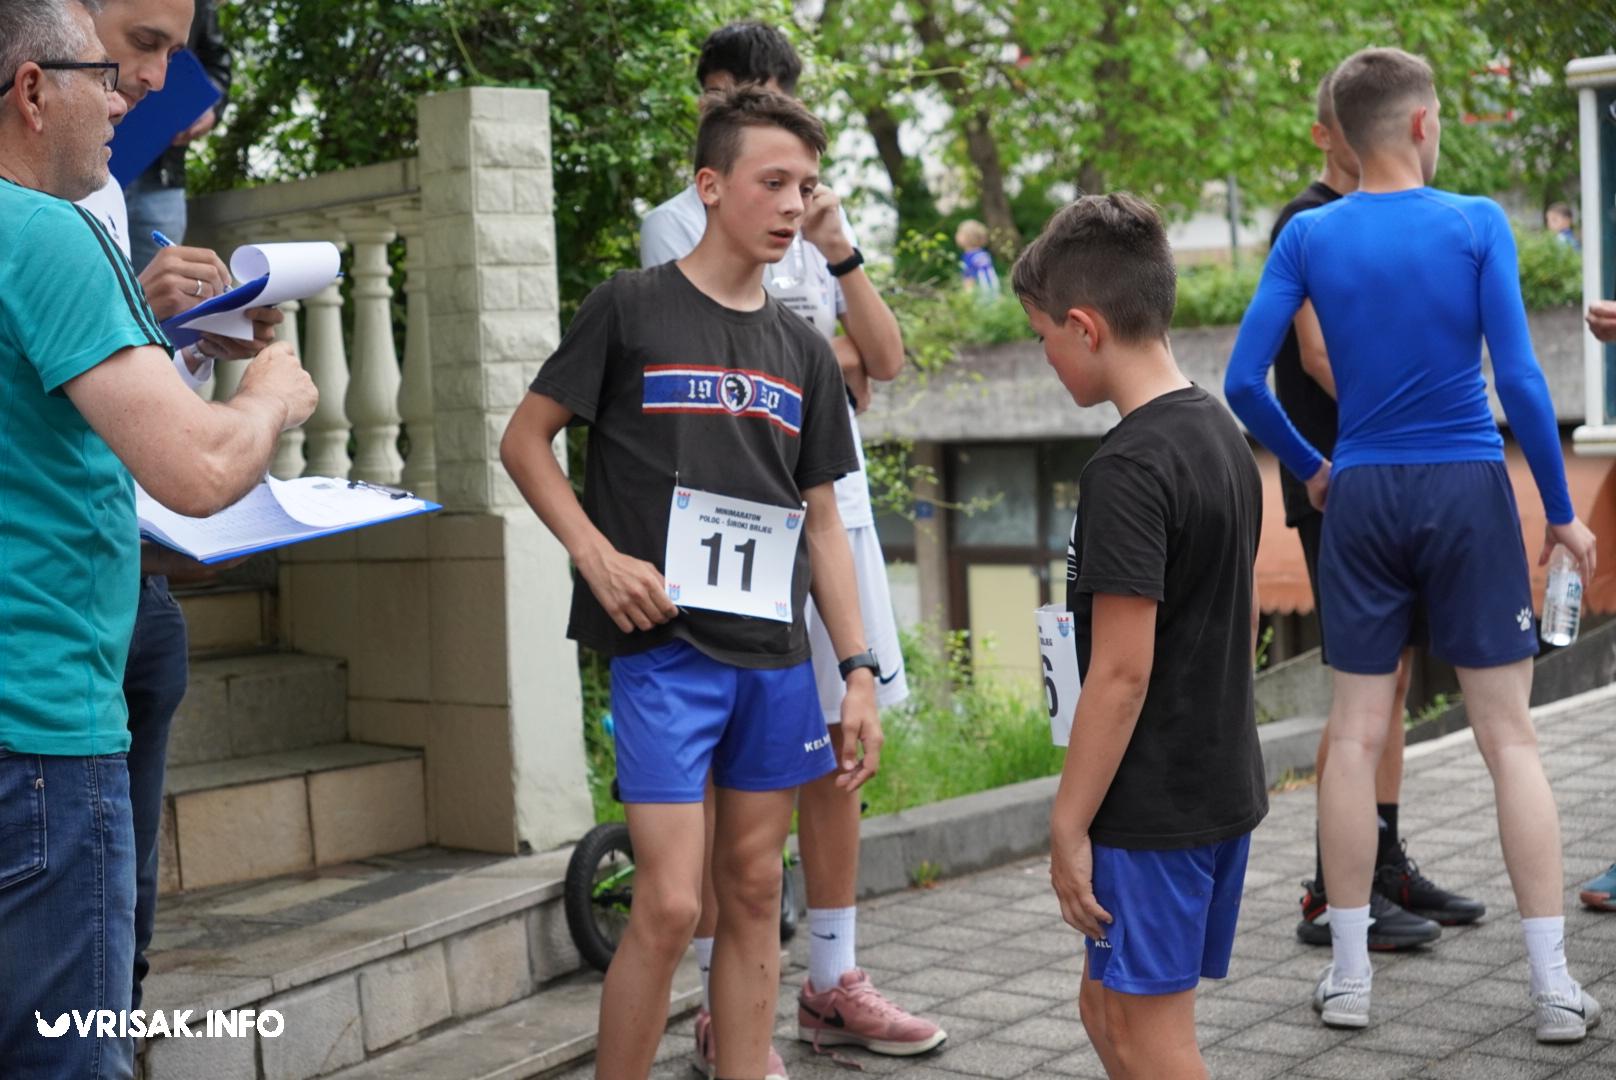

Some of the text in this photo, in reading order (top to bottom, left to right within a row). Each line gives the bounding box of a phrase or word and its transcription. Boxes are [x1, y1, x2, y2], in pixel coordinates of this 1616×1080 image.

[687, 379, 713, 399] 19
[699, 514, 720, 525] POLOG
[726, 518, 748, 530] ŠIROKI
[715, 506, 762, 522] MINIMARATON
[701, 532, 756, 592] 11
